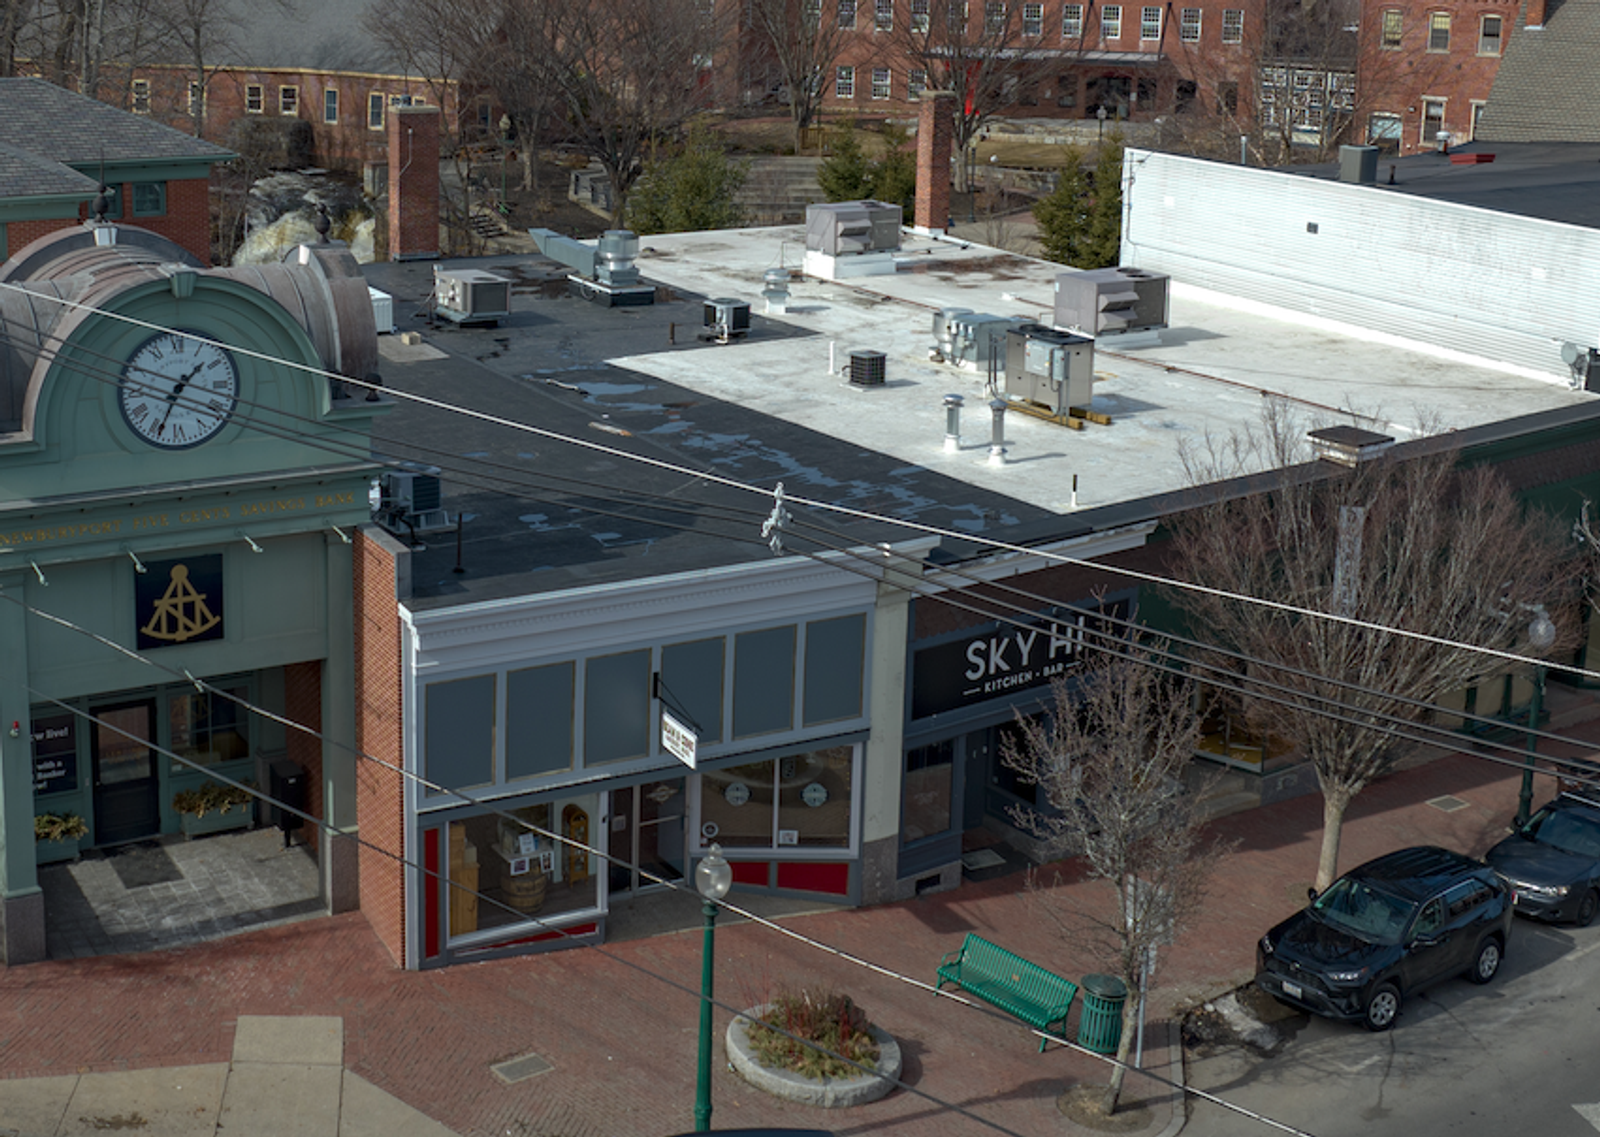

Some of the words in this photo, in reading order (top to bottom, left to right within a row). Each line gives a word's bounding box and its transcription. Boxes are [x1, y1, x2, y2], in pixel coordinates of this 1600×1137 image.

[0, 519, 122, 546] NEWBURYPORT
[133, 513, 169, 531] FIVE
[179, 506, 230, 524] CENTS
[240, 497, 306, 517] SAVINGS
[315, 491, 354, 508] BANK
[965, 630, 1037, 680] SKY
[984, 670, 1033, 693] KITCHEN
[1043, 662, 1063, 677] BAR
